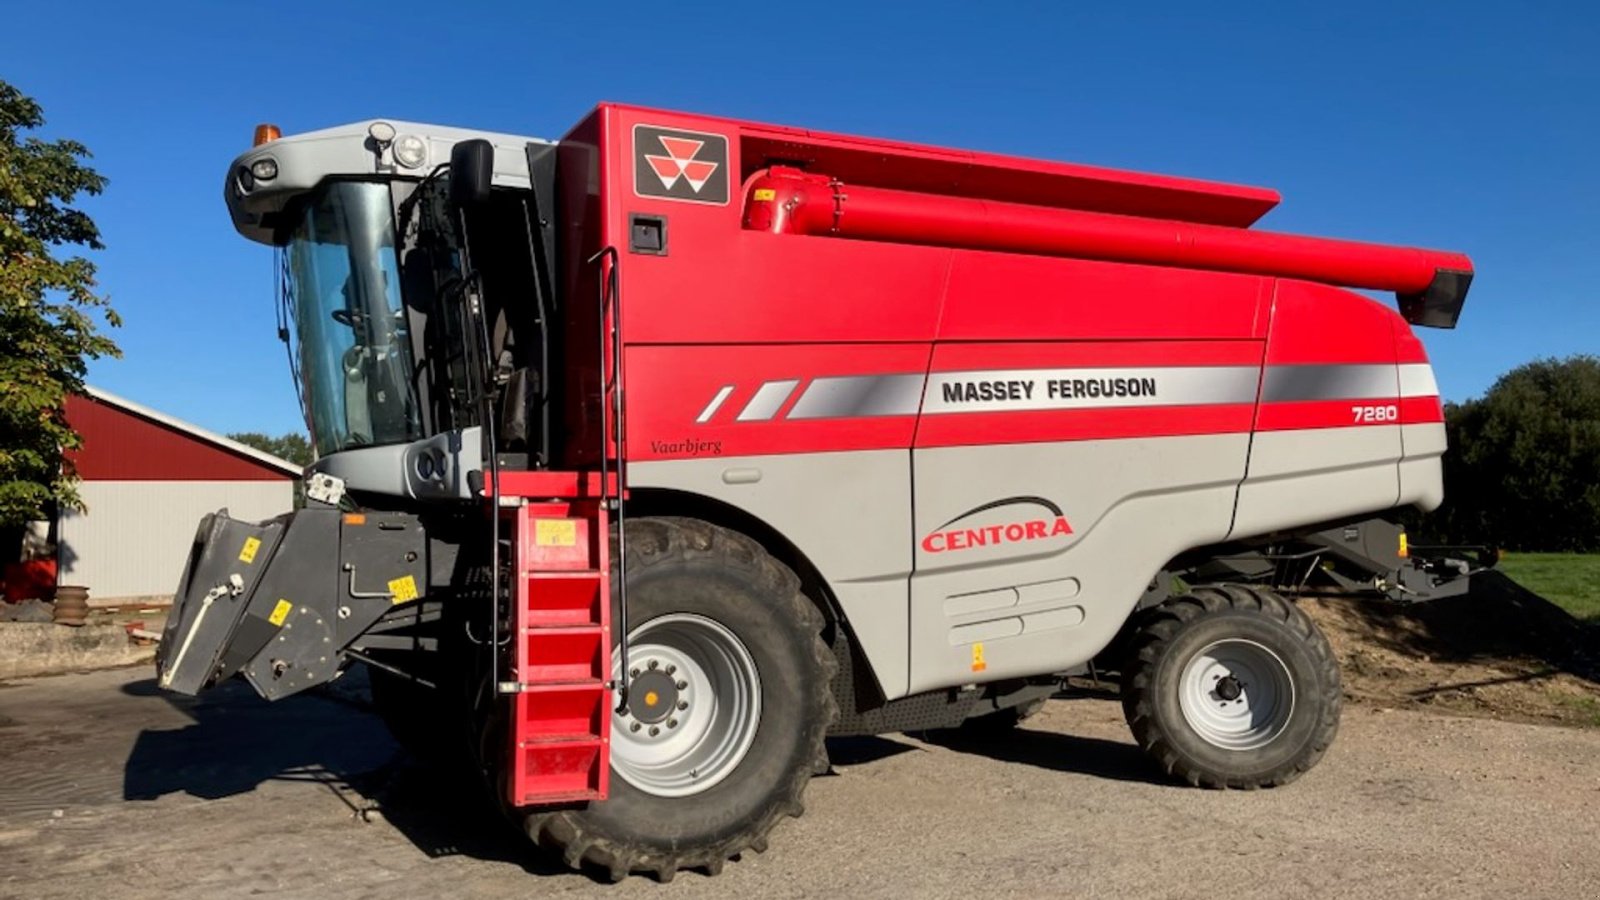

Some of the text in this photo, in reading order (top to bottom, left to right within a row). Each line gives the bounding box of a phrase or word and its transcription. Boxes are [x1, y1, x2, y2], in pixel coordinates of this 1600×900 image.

[942, 378, 1156, 403] MASSEY FERGUSON
[1351, 405, 1398, 422] 7280
[651, 438, 722, 456] Vaarbjerg
[921, 517, 1073, 553] CENTORA
